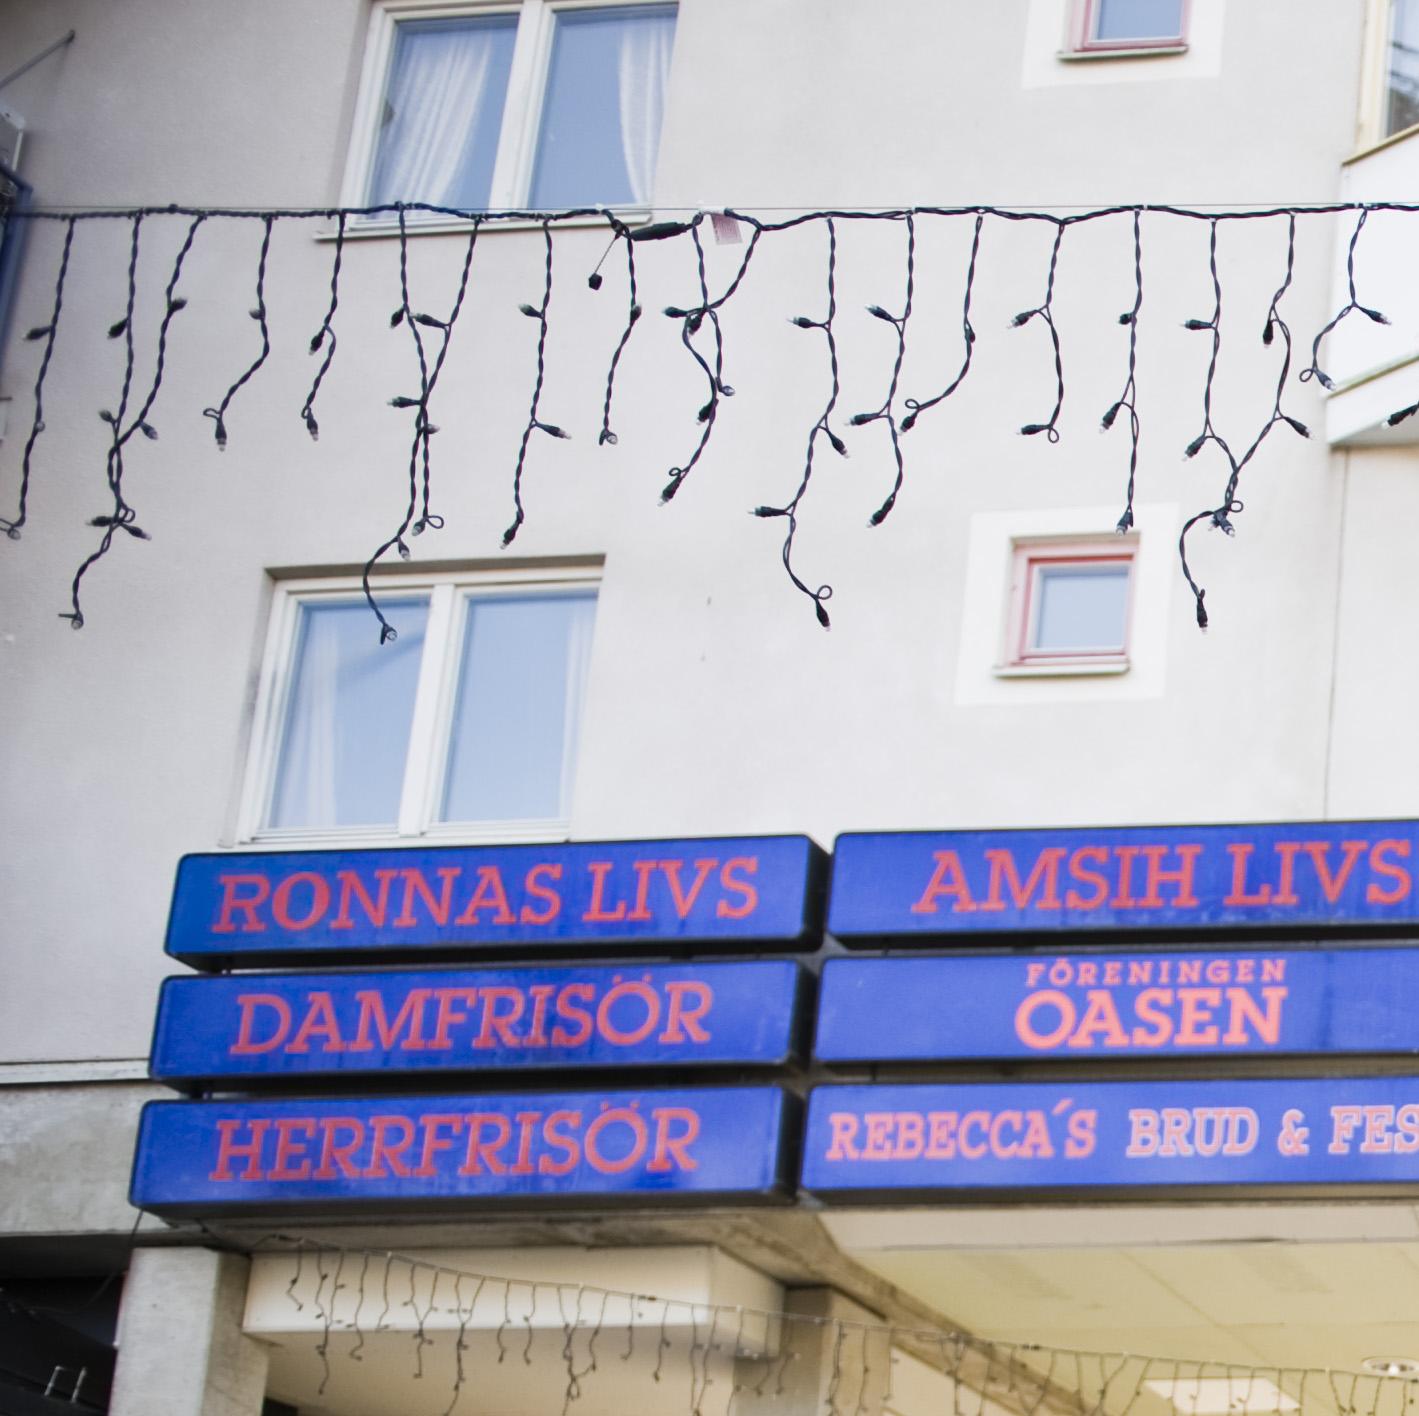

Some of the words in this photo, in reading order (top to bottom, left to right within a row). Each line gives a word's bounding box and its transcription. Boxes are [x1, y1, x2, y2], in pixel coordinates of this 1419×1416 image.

[211, 863, 562, 933] RONNAS
[582, 856, 759, 922] LIVS
[911, 844, 1202, 912] AMSIH
[1222, 839, 1413, 906] LIVS
[1025, 958, 1287, 986] FÖRENINGEN
[229, 974, 713, 1055] DAMFRISÖR
[1014, 986, 1287, 1050] OASEN
[209, 1101, 700, 1182] HERRFRISÖR
[1126, 1107, 1259, 1157] BRUD
[1277, 1109, 1310, 1155] &
